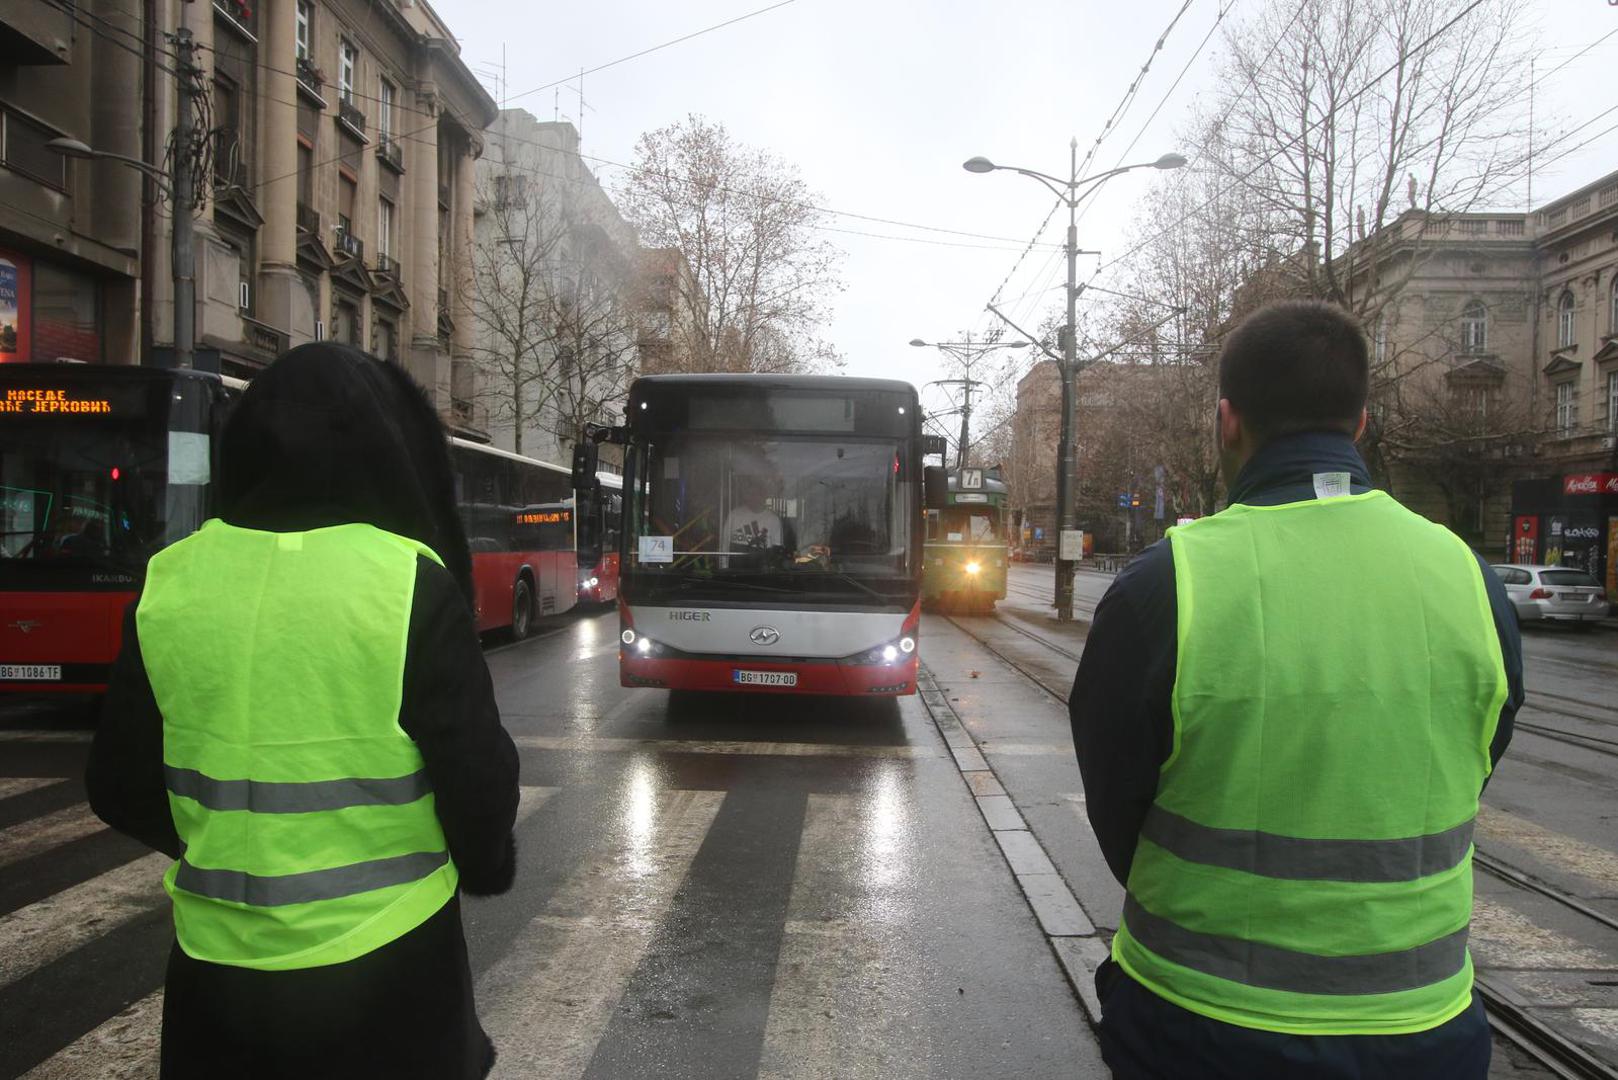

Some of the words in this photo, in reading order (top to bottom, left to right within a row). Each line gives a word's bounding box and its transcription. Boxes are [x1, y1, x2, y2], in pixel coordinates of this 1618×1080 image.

[650, 540, 665, 551] 74
[669, 611, 711, 621] HIGER
[741, 672, 753, 683] BG
